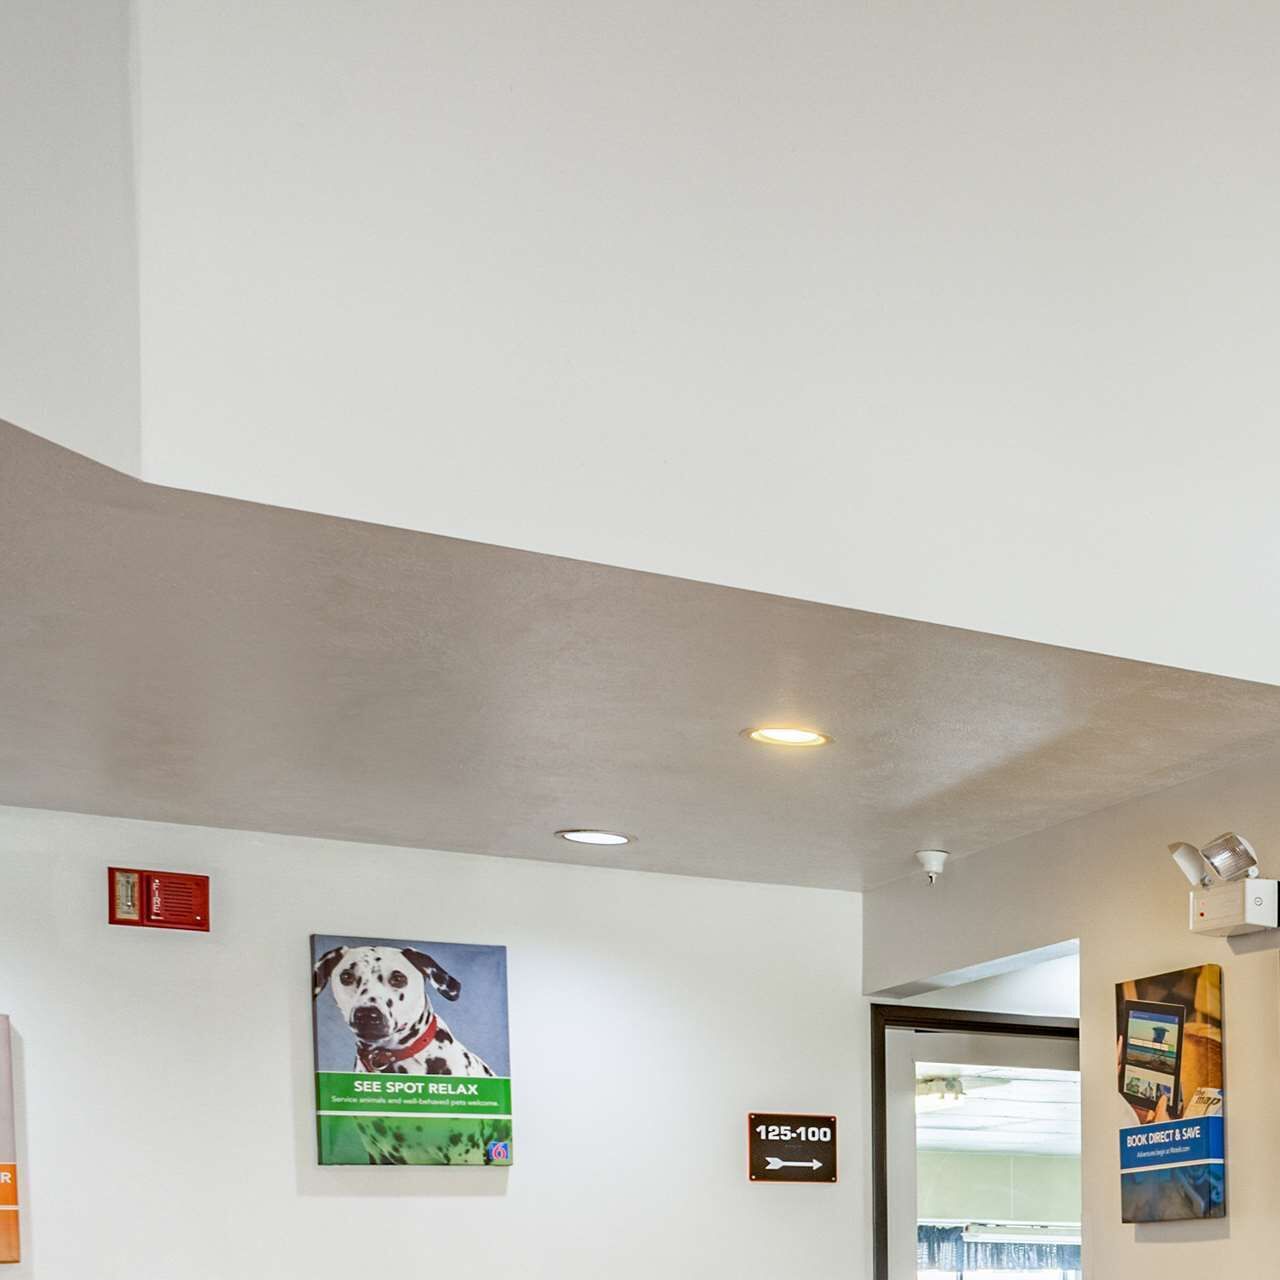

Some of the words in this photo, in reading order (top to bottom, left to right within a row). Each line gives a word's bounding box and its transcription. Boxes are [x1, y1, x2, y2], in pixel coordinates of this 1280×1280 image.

[354, 1080, 381, 1092] SEE
[386, 1081, 424, 1094] SPOT
[428, 1083, 478, 1095] RELAX
[331, 1095, 358, 1103] Service
[359, 1096, 386, 1104] animals
[403, 1097, 449, 1106] well-behaved
[450, 1099, 466, 1107] pets
[1196, 1095, 1221, 1108] map
[756, 1125, 831, 1142] 125-100
[1127, 1133, 1148, 1148] BOOK
[1149, 1129, 1174, 1144] DIRECT
[1174, 1129, 1181, 1141] &
[1182, 1126, 1200, 1140] SAVE
